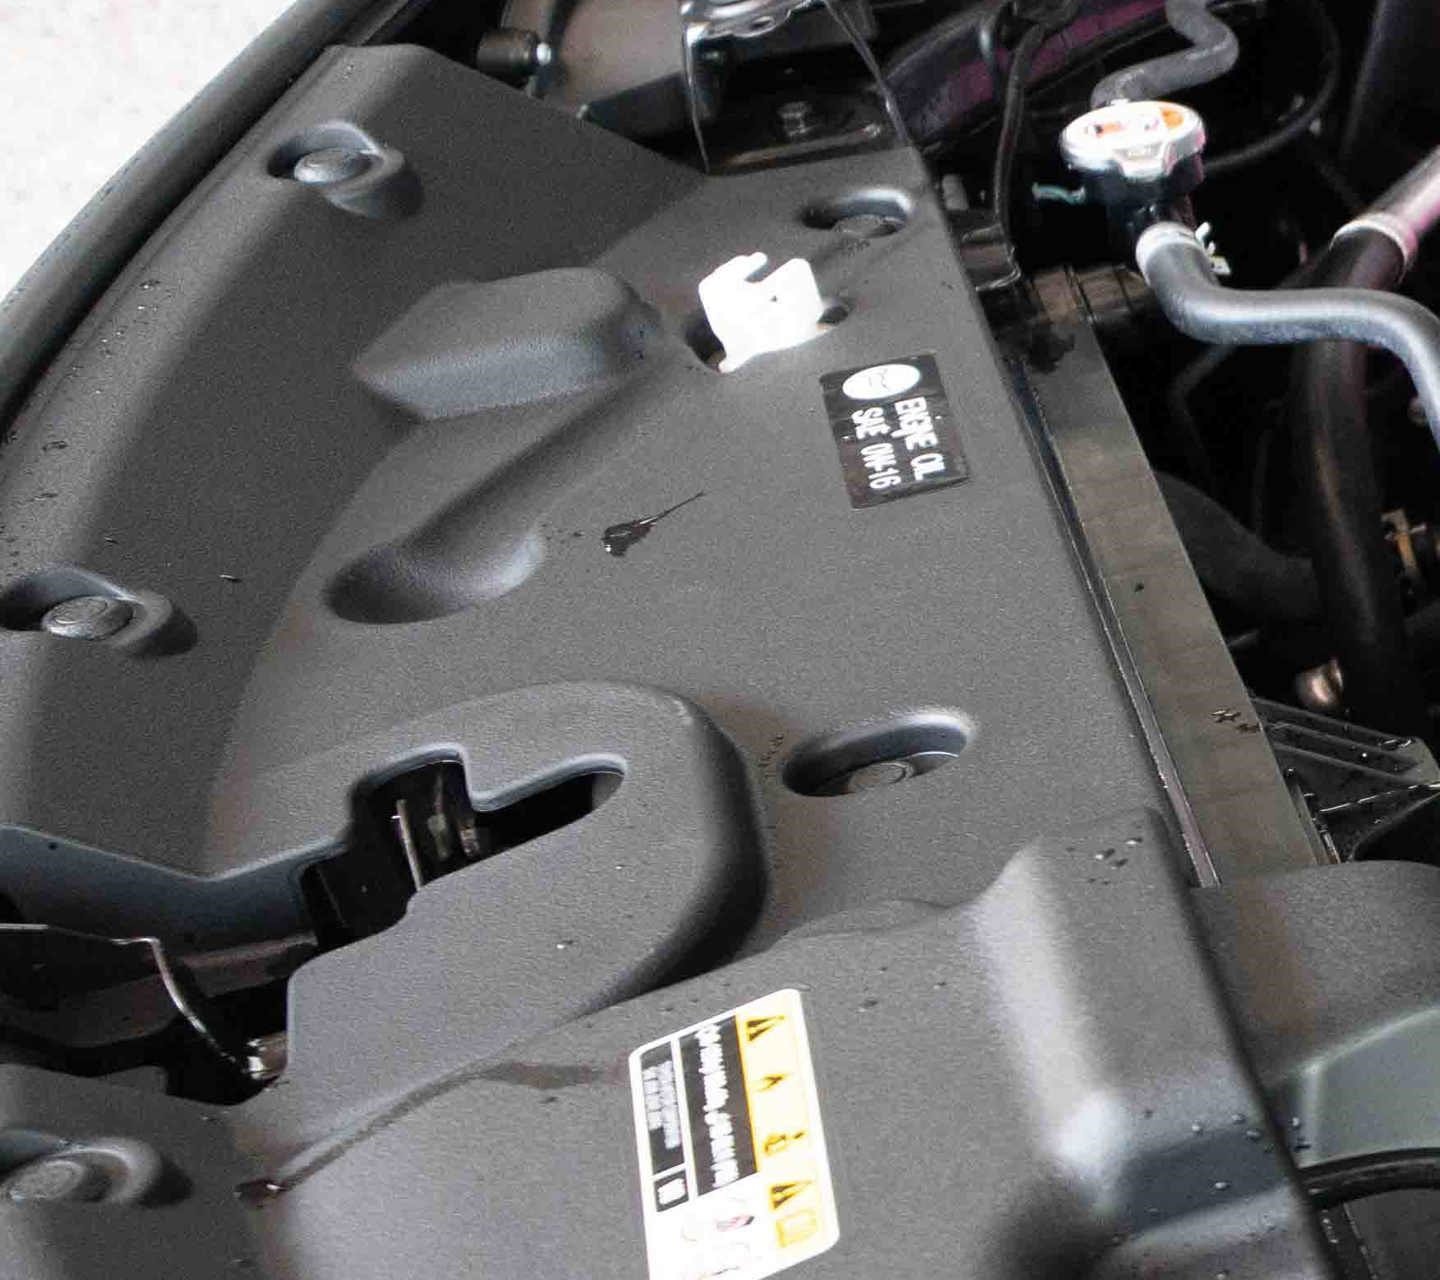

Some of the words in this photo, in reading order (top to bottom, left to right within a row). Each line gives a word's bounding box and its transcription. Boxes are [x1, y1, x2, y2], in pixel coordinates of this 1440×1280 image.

[851, 406, 891, 440] SAE
[891, 396, 939, 451] ENGINE
[860, 442, 902, 490] 0W-16
[910, 452, 946, 481] OIL
